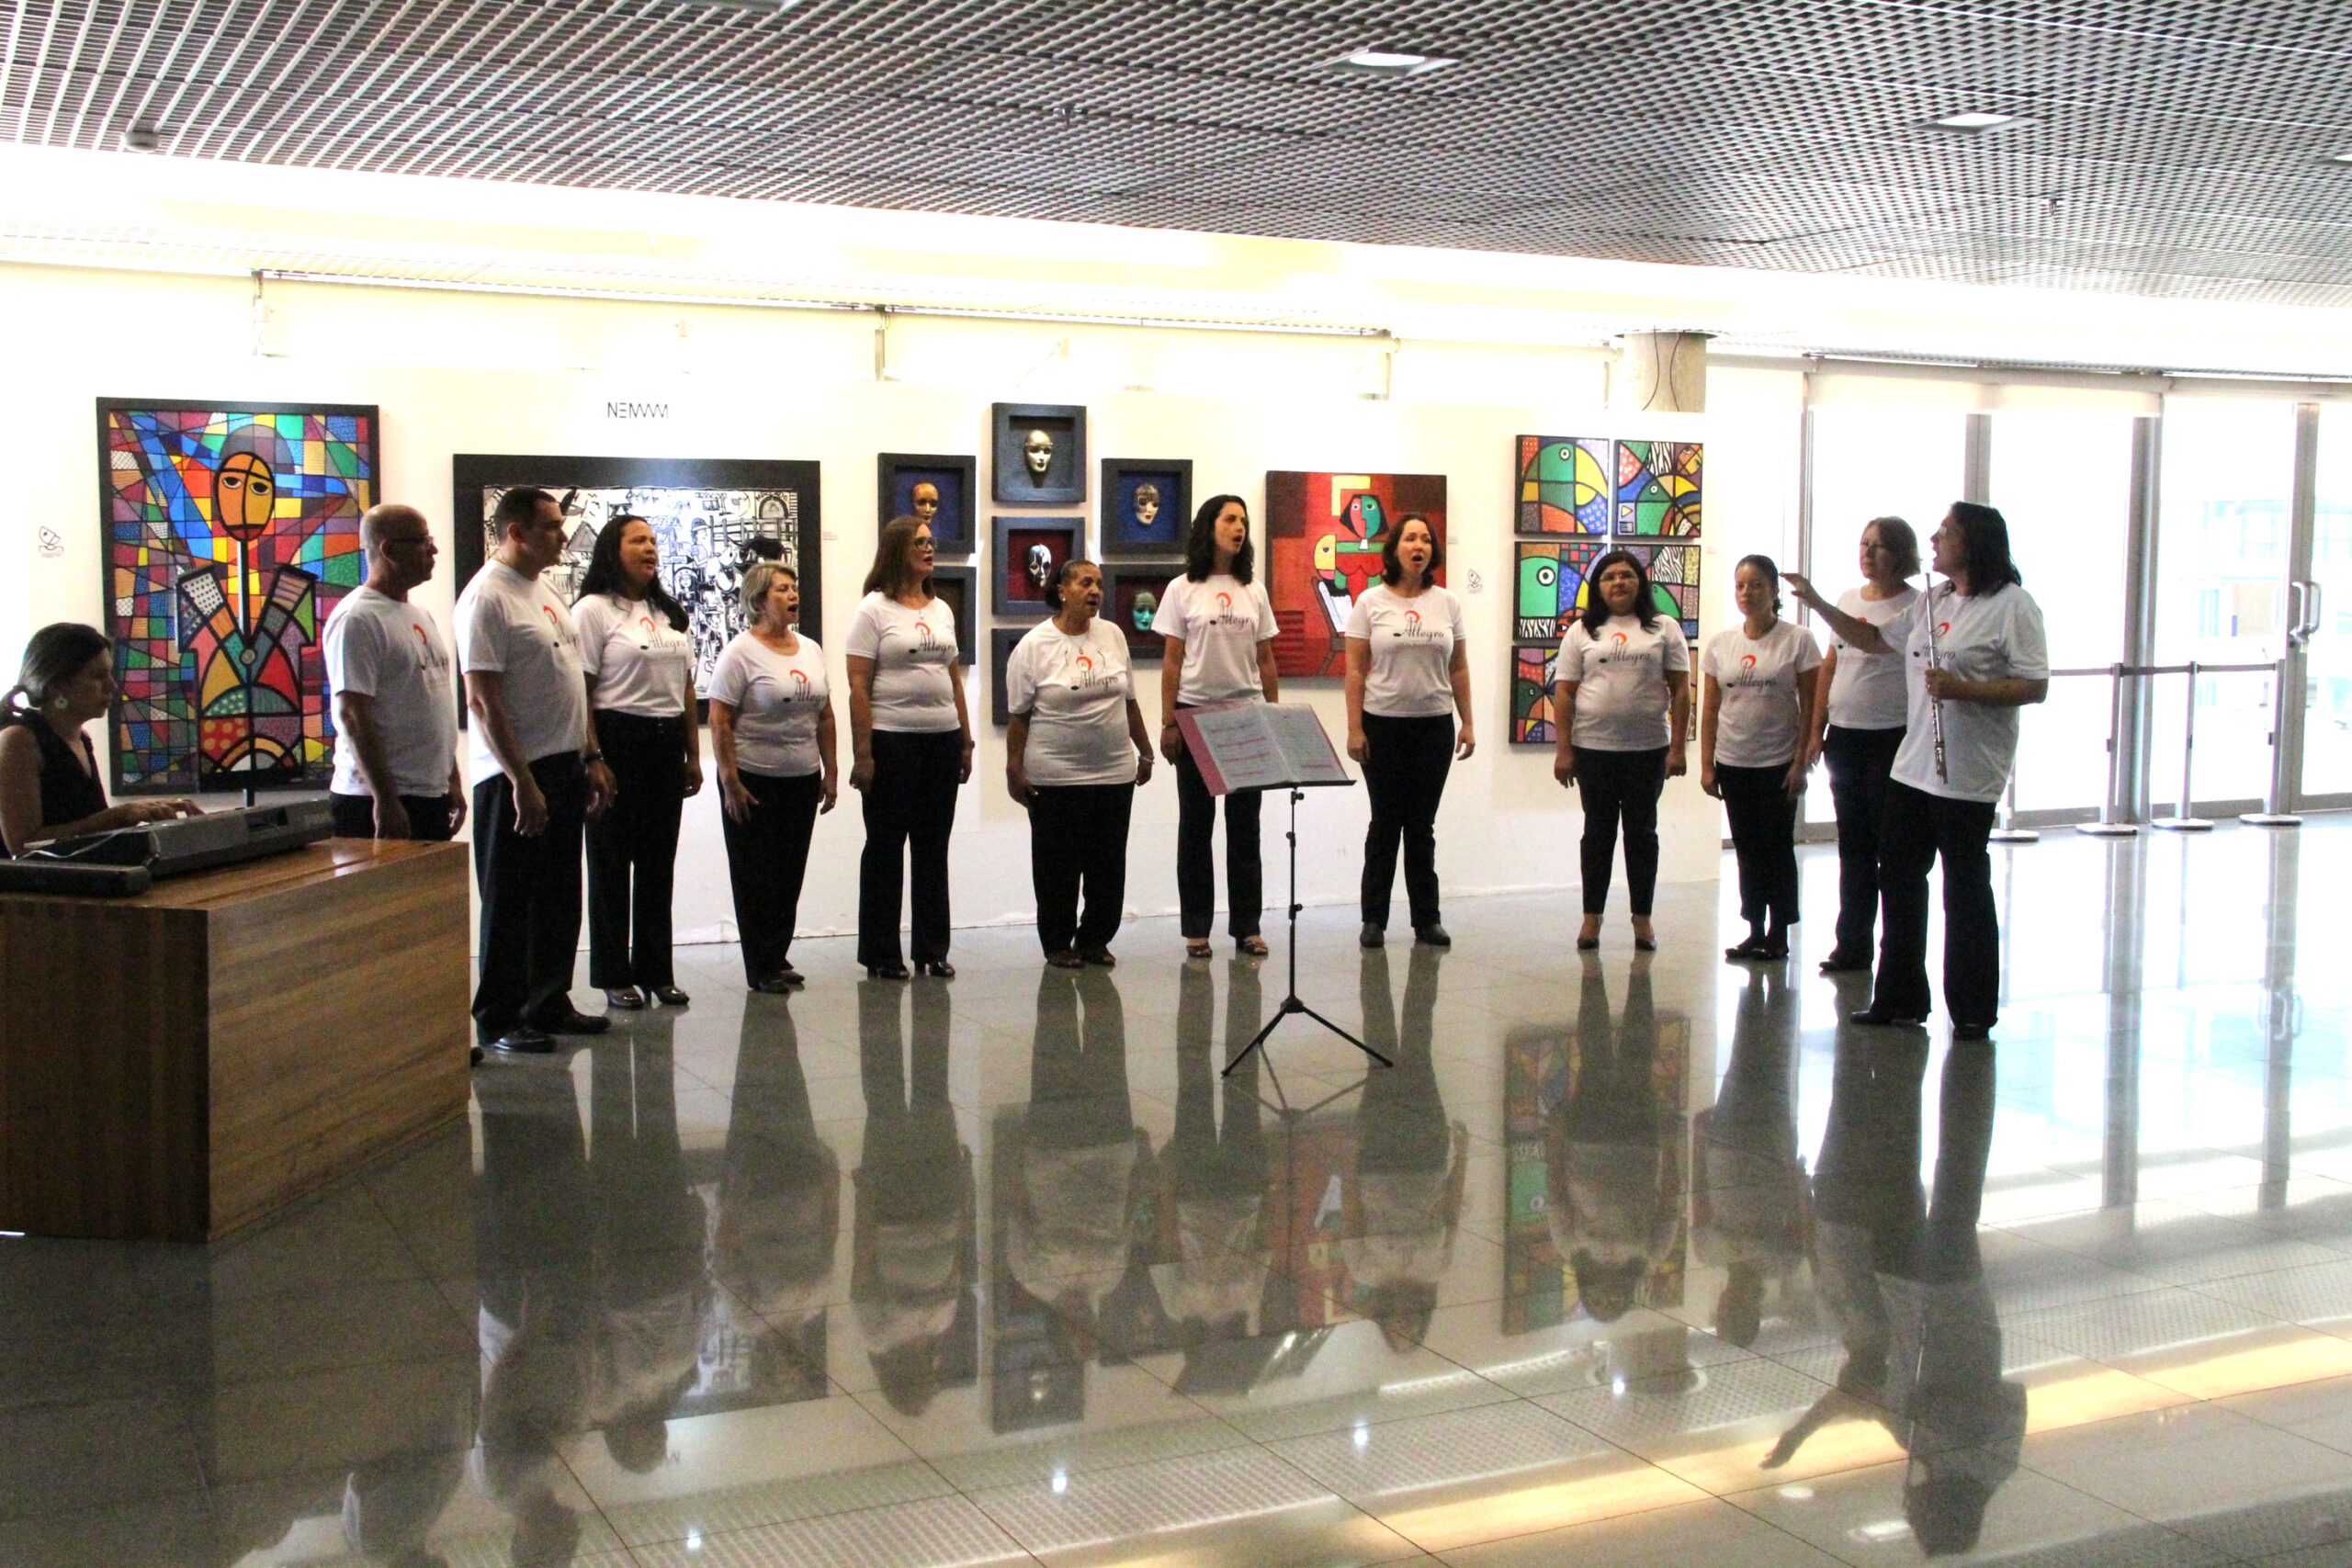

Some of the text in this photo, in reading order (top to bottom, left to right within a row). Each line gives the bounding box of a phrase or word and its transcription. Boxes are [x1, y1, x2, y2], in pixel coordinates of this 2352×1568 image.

[646, 626, 686, 654] Allegro
[1404, 616, 1444, 642] Allegro
[1609, 639, 1651, 665] Allegro
[1080, 663, 1119, 689] Allegro
[1736, 661, 1777, 693] Allegro
